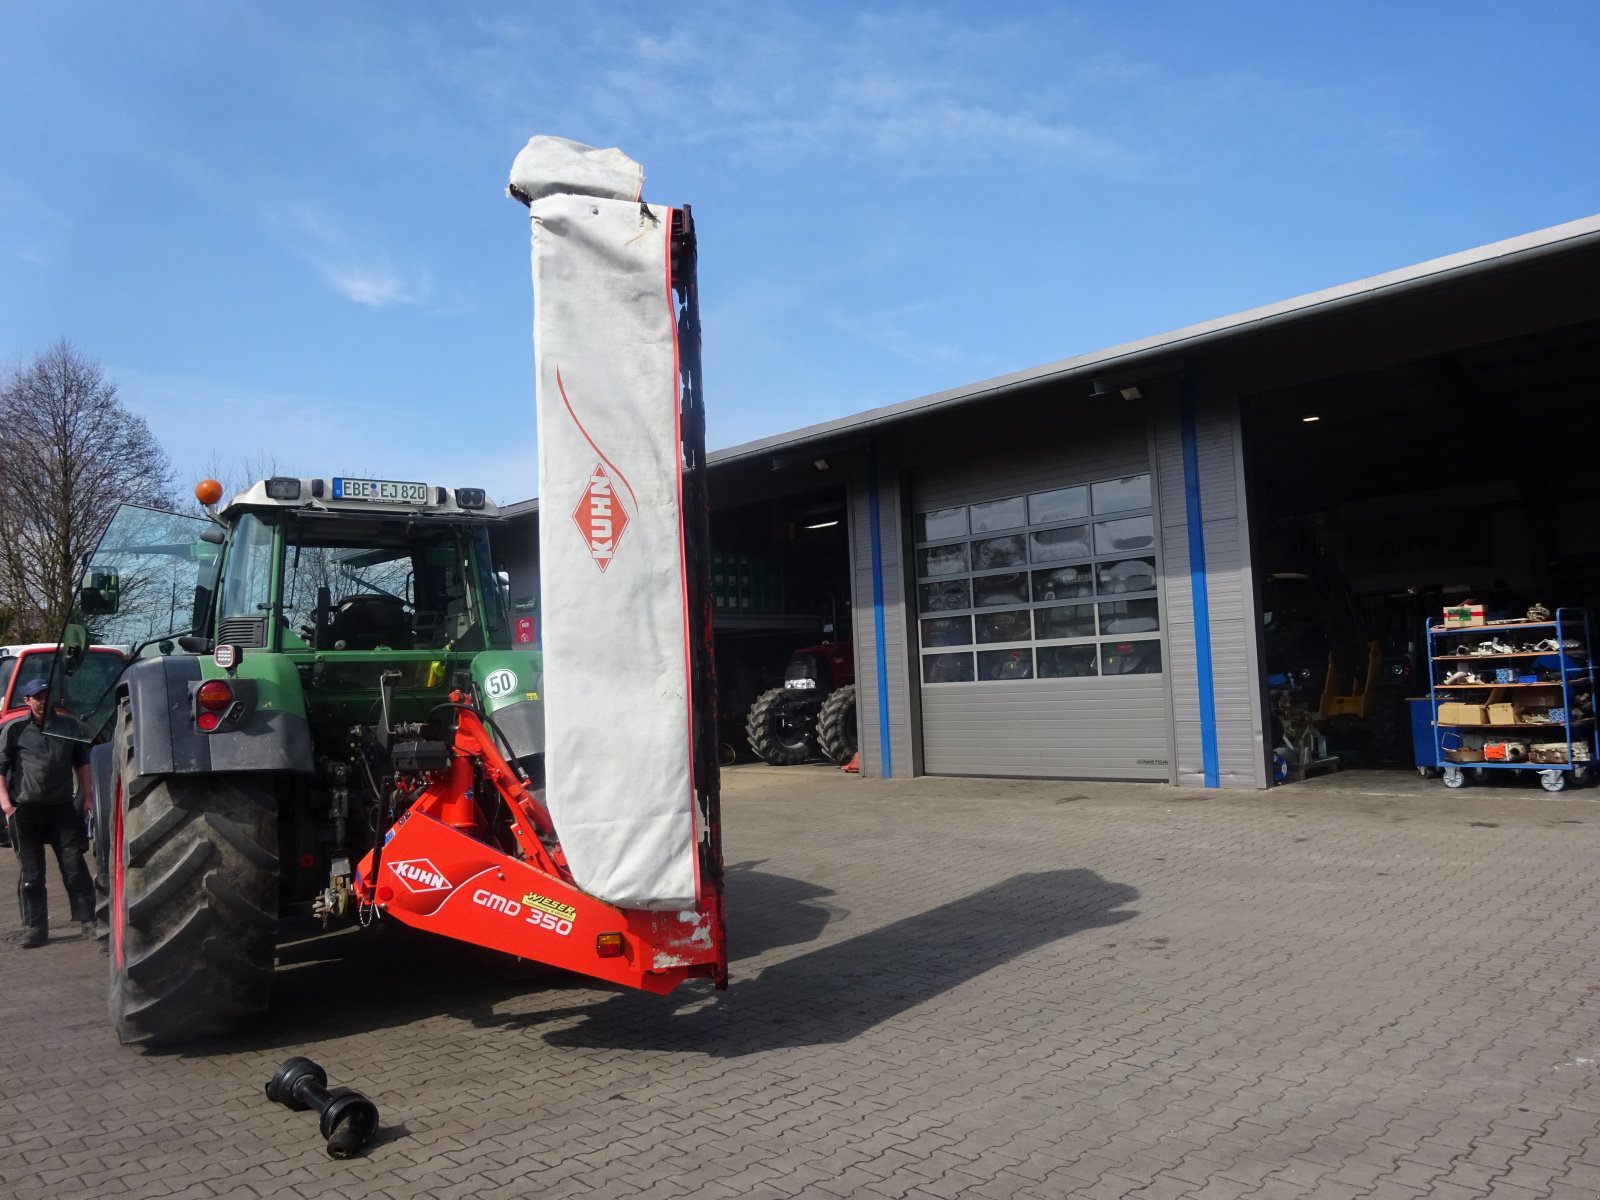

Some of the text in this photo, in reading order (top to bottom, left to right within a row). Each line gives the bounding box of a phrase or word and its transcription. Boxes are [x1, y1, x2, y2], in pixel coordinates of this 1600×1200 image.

[343, 481, 370, 497] EBE
[380, 483, 398, 499] EJ
[401, 485, 425, 500] 820
[590, 475, 613, 559] KUHN
[490, 672, 511, 695] 50
[394, 862, 445, 889] KUHN
[472, 889, 522, 917] GMD
[525, 908, 573, 936] 350
[527, 891, 576, 915] WIESER
